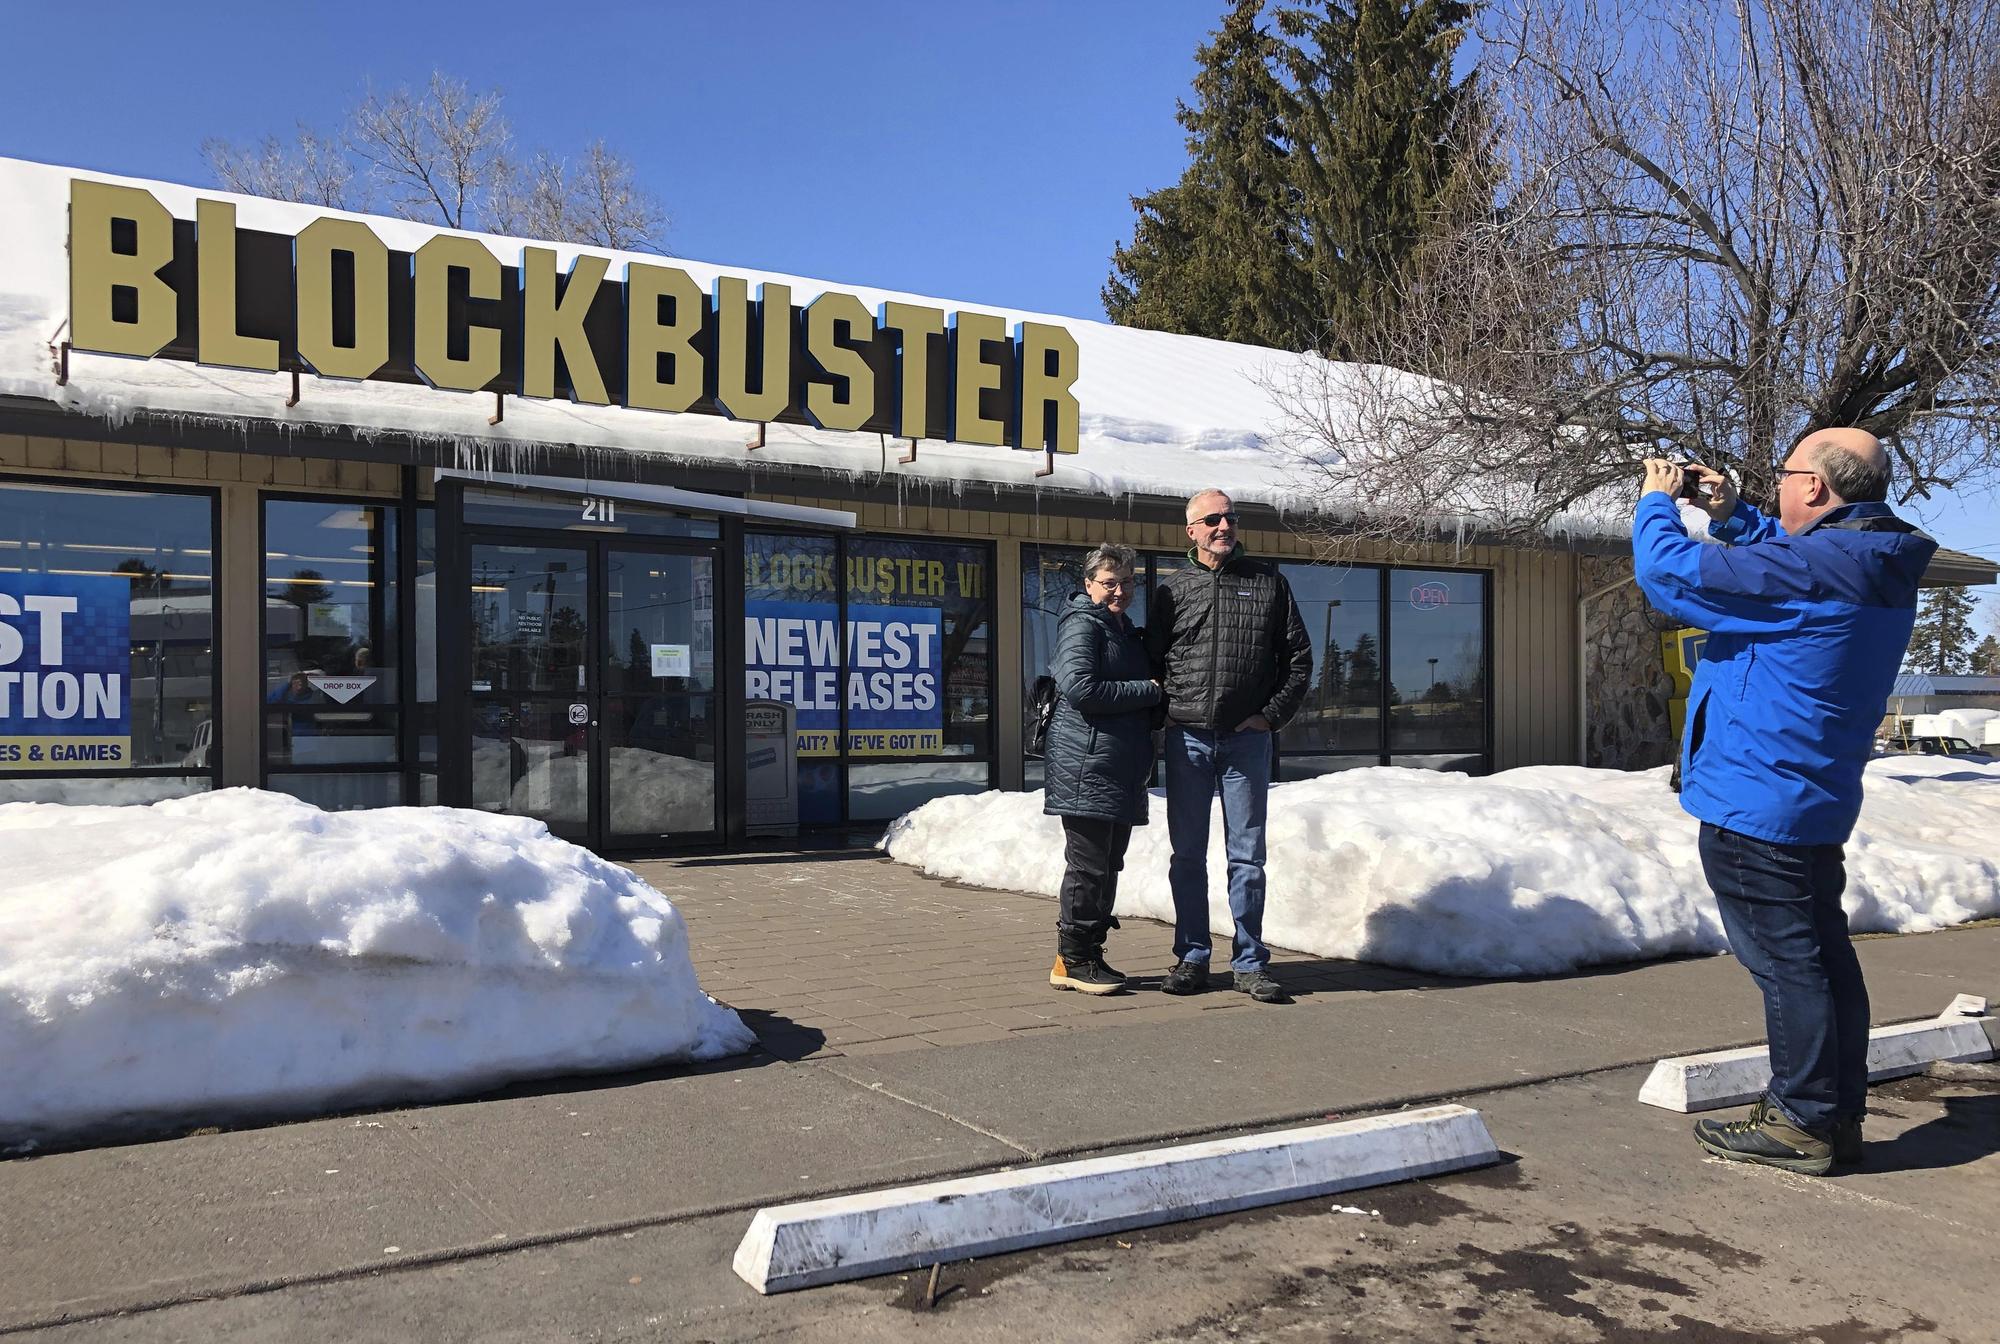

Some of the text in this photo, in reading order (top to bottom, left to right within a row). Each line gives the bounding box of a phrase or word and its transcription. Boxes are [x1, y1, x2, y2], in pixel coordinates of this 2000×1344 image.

[70, 178, 1079, 454] BLOCKBUSTER
[582, 497, 615, 522] 211
[1410, 587, 1449, 606] OPEN
[745, 616, 937, 669] NEWEST
[745, 670, 936, 711] RELEASES
[745, 720, 777, 728] ONLY
[746, 712, 781, 720] RASH
[796, 735, 938, 751] AIT? WE'VE GOT IT!
[28, 744, 44, 762] &
[50, 744, 122, 762] GAMES
